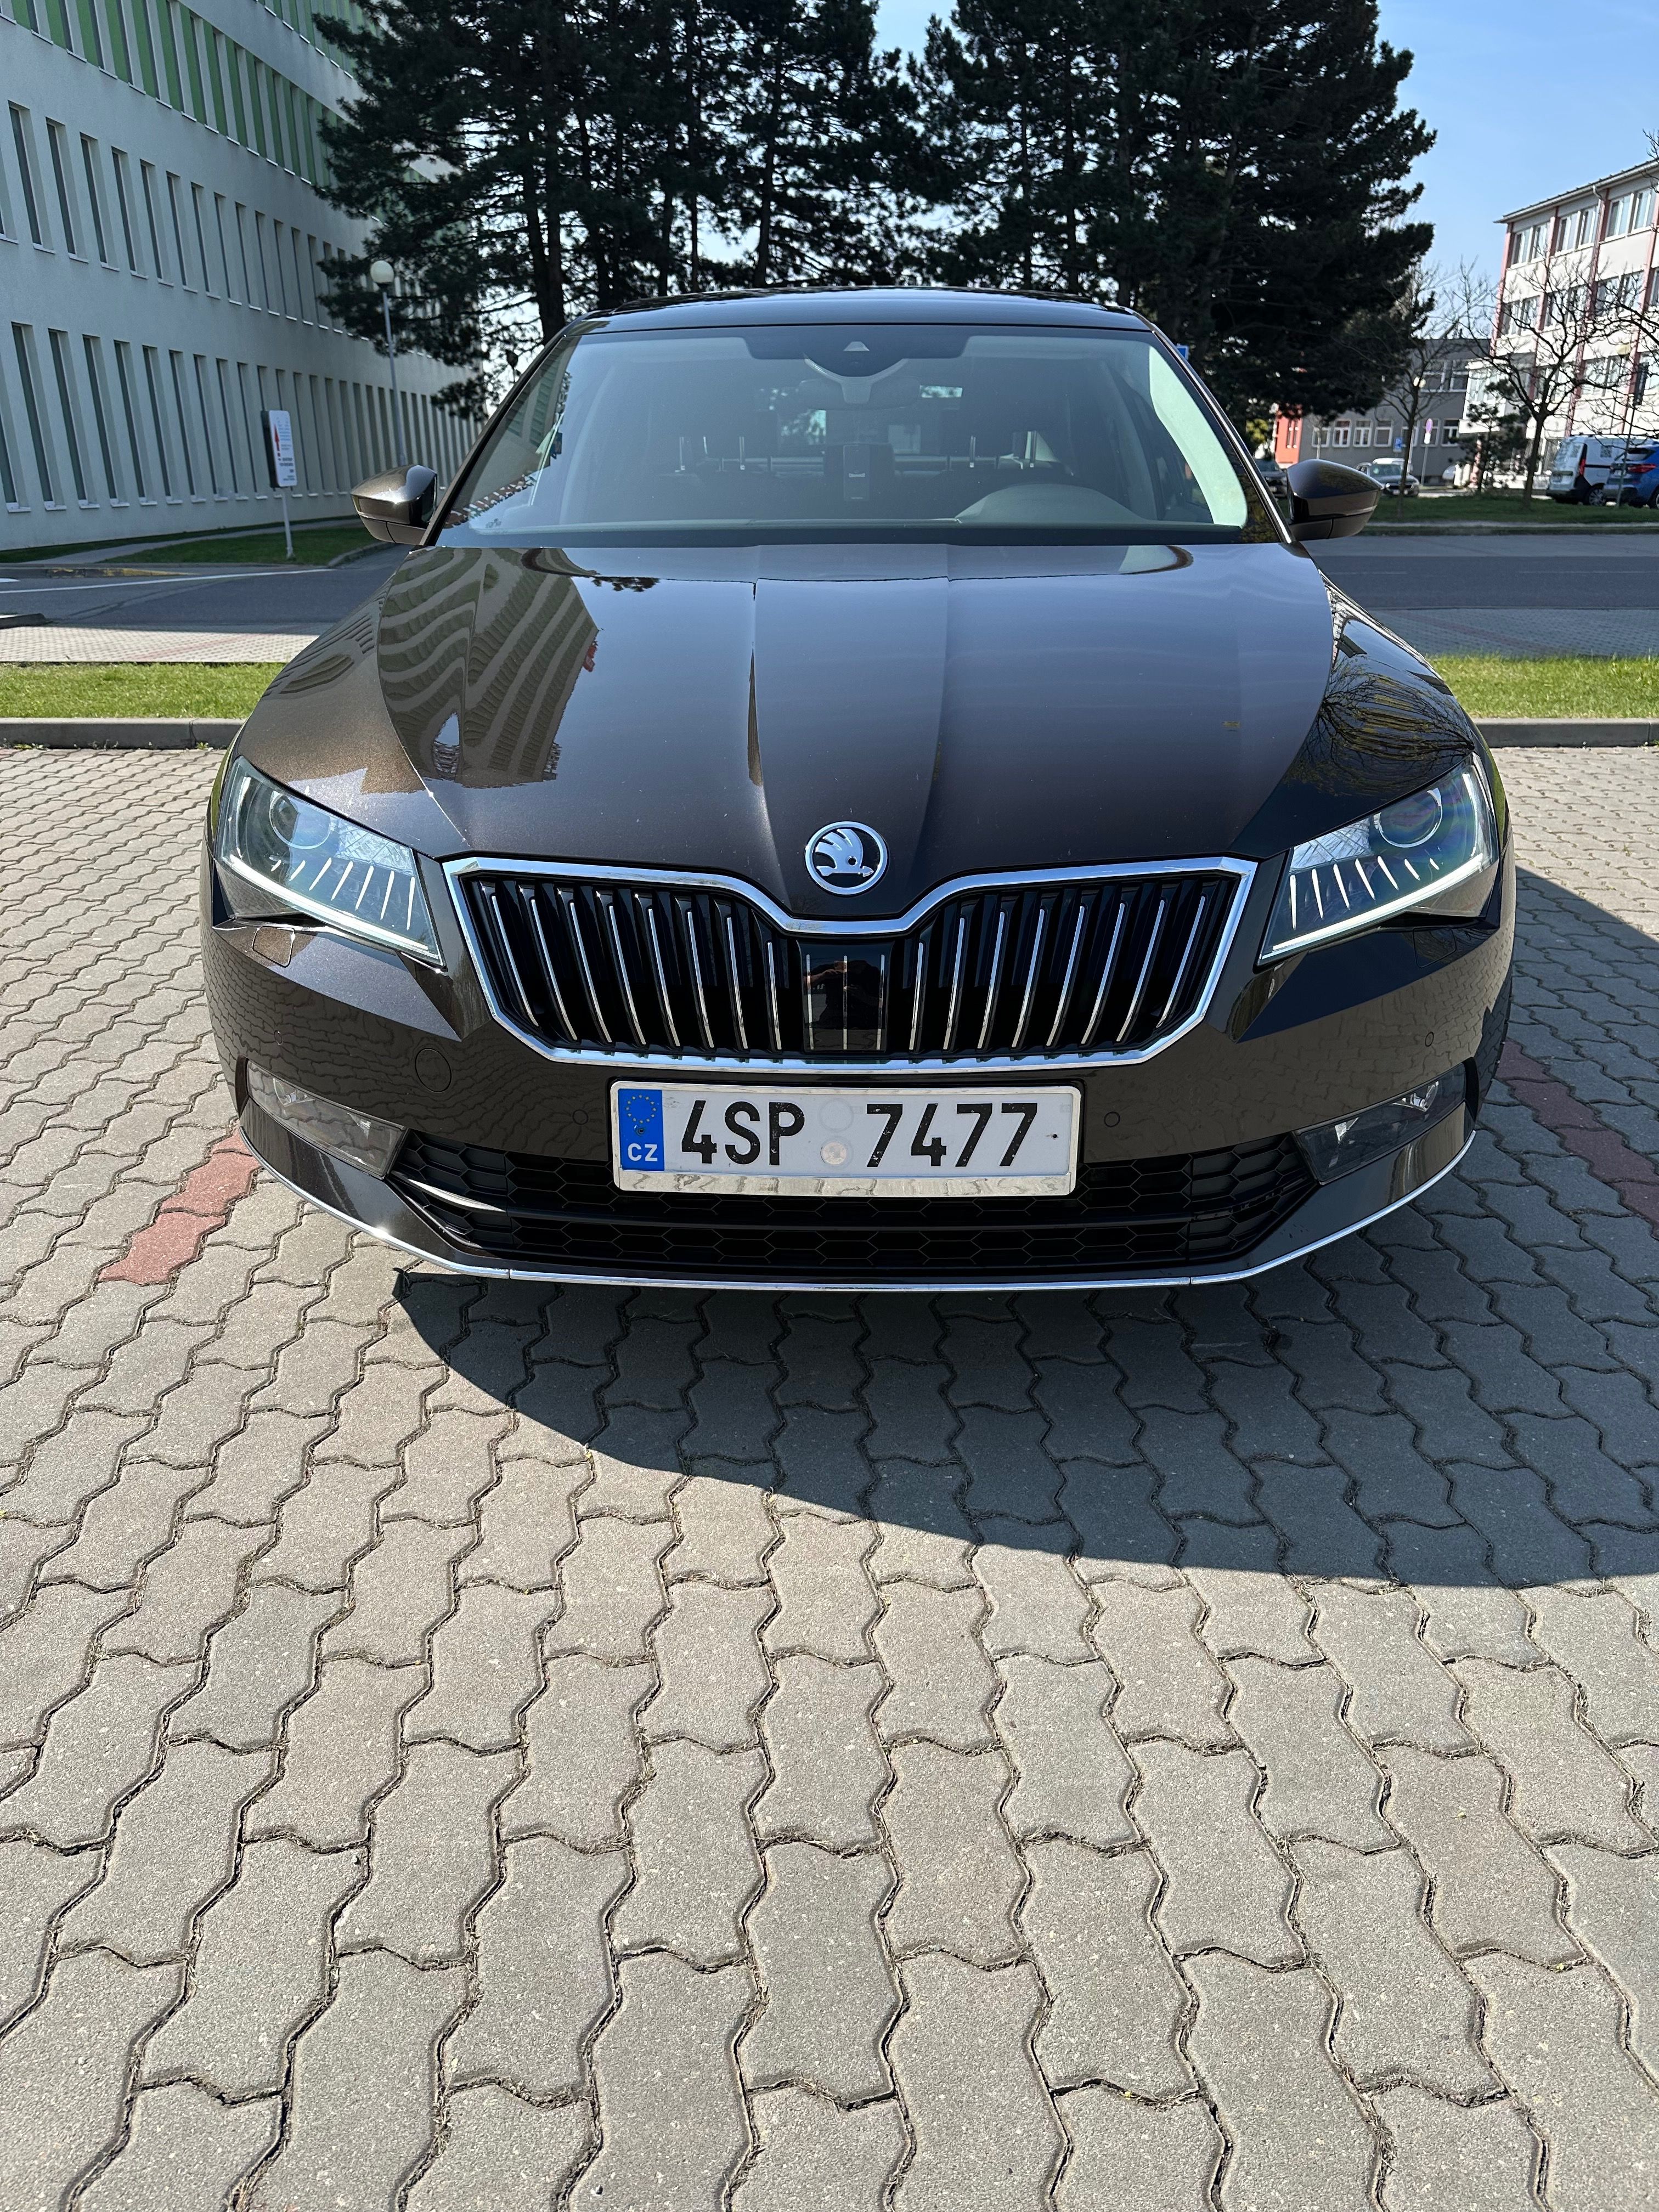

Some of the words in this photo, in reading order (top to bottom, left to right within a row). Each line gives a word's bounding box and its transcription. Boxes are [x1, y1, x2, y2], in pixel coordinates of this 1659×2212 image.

[628, 1143, 658, 1161] CZ
[681, 1100, 805, 1166] 4SP
[866, 1102, 1039, 1167] 7477
